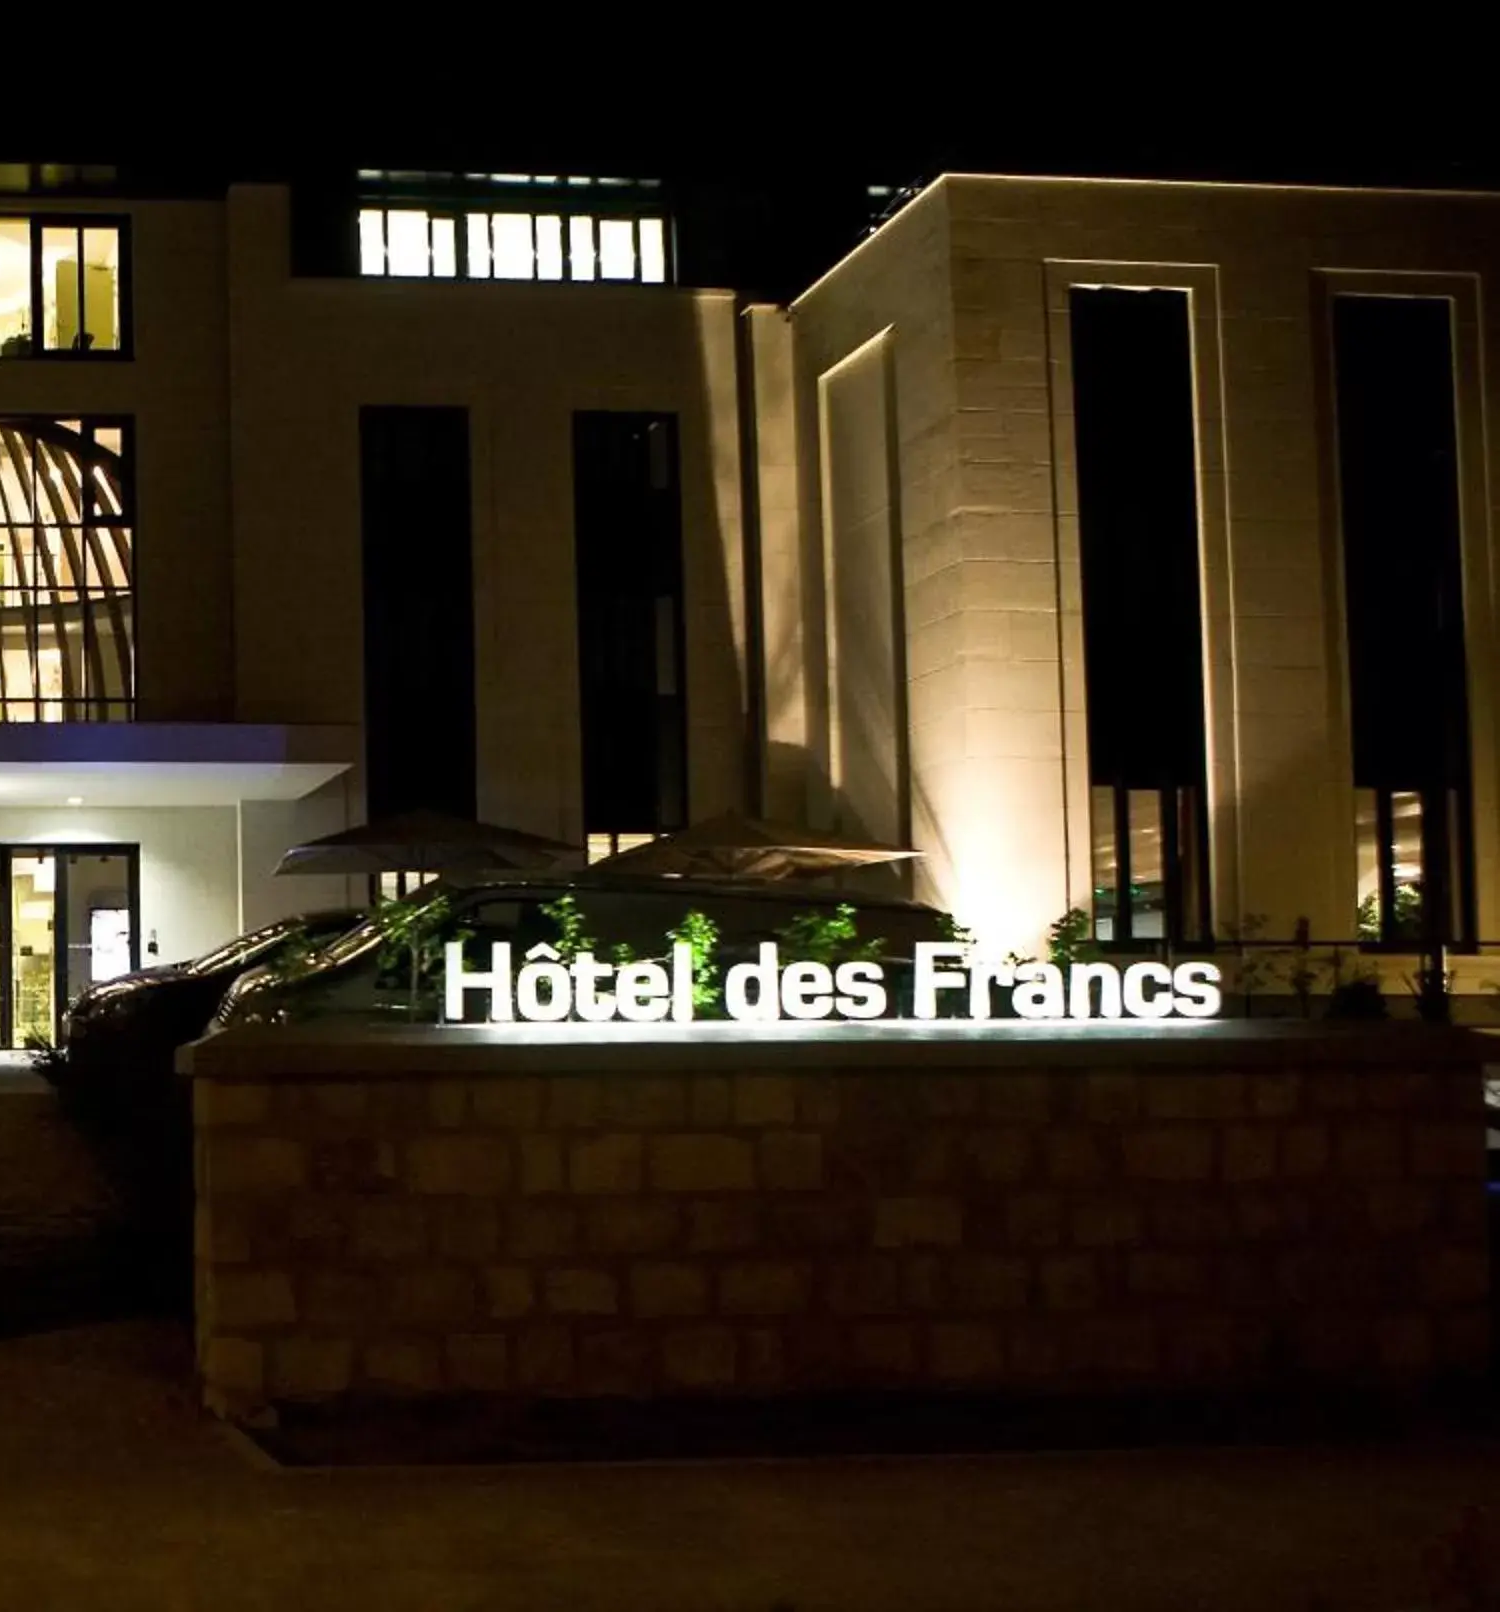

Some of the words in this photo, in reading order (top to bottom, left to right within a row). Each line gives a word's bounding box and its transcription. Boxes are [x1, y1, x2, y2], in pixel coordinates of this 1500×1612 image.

[444, 941, 691, 1021] Hôtel
[725, 942, 887, 1019] des
[914, 941, 1222, 1019] Francs
